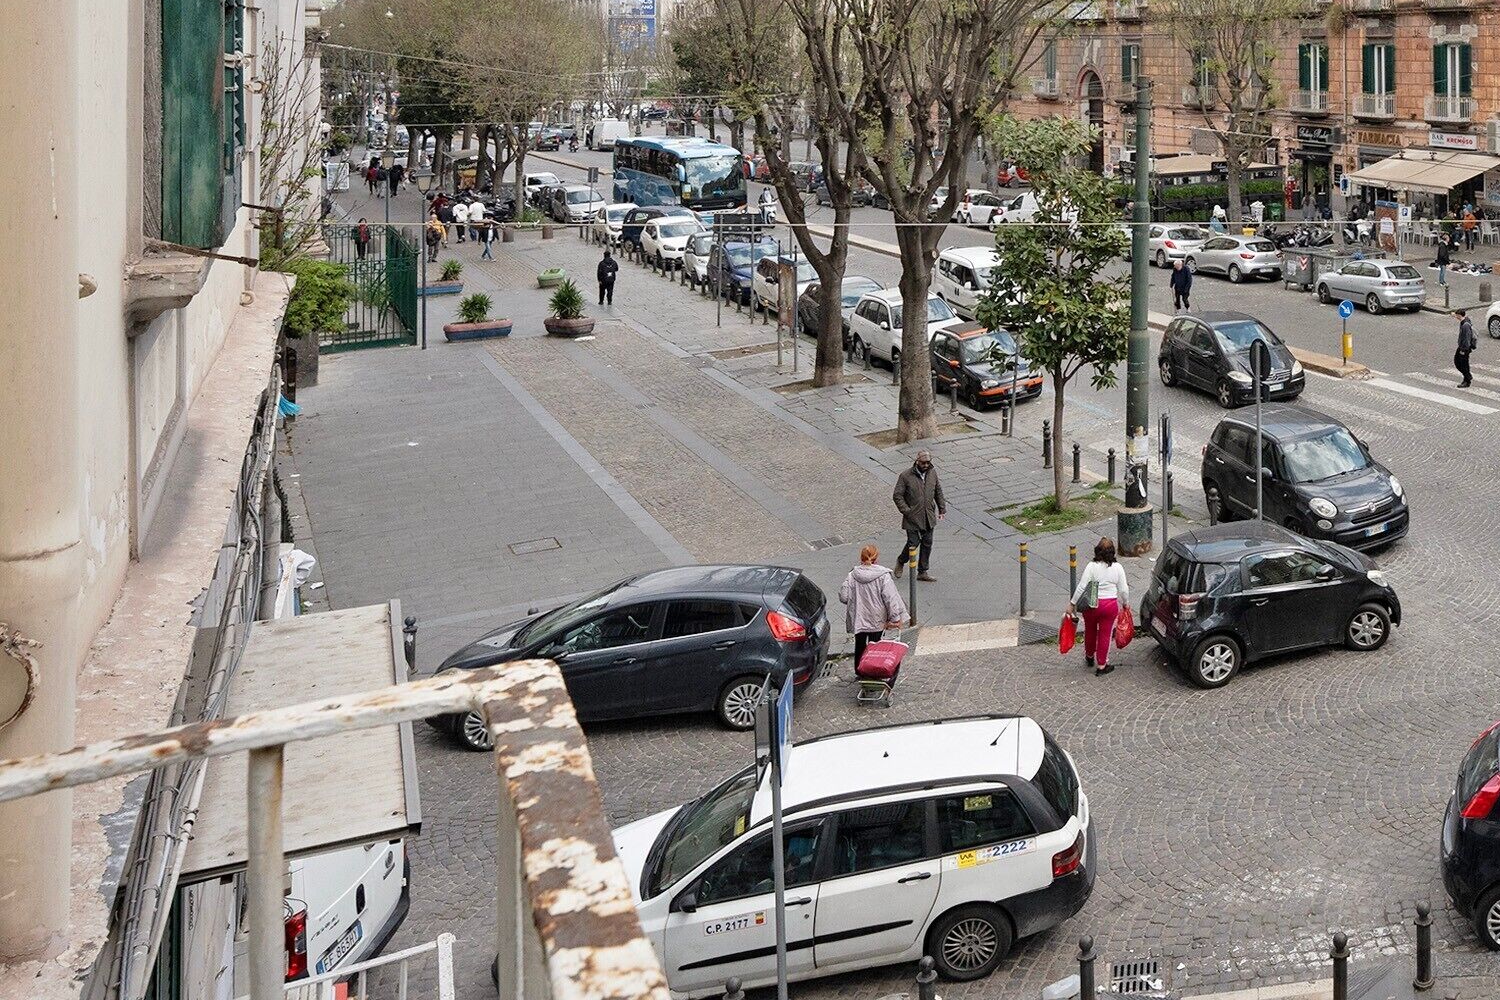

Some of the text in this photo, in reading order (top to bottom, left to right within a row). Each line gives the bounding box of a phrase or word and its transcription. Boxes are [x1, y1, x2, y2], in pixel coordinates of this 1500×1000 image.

[1357, 130, 1401, 146] FARMACIA
[1431, 133, 1444, 141] BAR
[992, 840, 1027, 857] 2222
[725, 919, 748, 931] 2177
